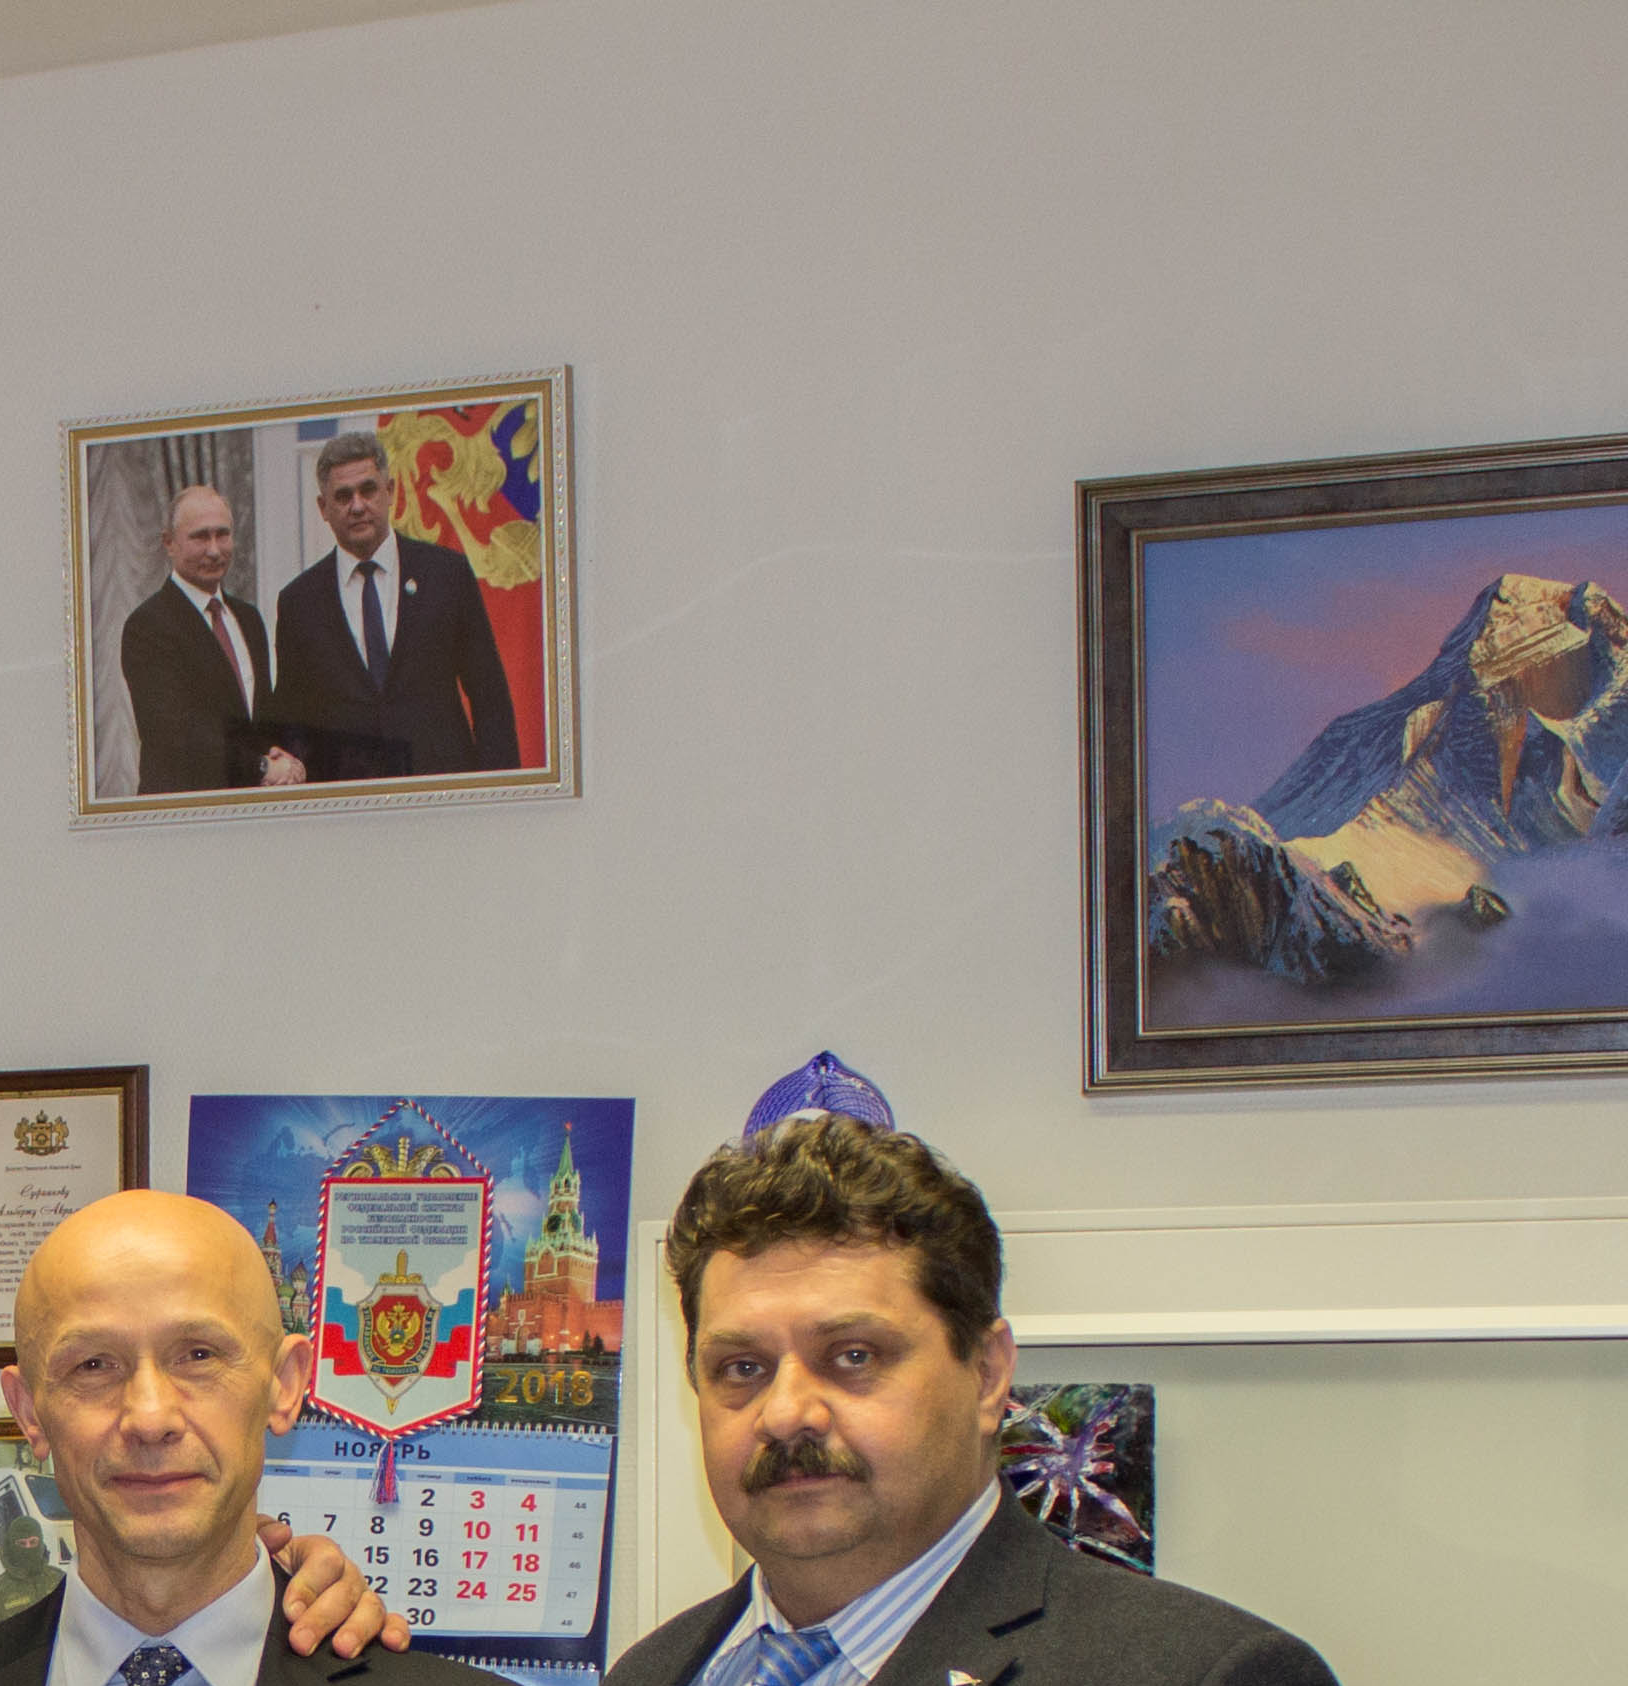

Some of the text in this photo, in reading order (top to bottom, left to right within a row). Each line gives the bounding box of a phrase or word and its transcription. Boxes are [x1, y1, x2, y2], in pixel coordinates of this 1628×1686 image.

[494, 1368, 595, 1408] 2018
[420, 1488, 435, 1507] 2
[470, 1490, 486, 1509] 3
[521, 1493, 537, 1512] 4
[323, 1514, 337, 1532] 7
[370, 1516, 385, 1535] 8
[419, 1518, 435, 1537] 9
[463, 1521, 491, 1540] 10
[515, 1523, 539, 1543] 11
[364, 1546, 390, 1565] 15
[413, 1548, 439, 1567] 16
[462, 1550, 489, 1569] 17
[512, 1553, 540, 1573] 18
[408, 1577, 438, 1597] 23
[456, 1580, 488, 1600] 24
[506, 1583, 537, 1602] 25
[407, 1607, 436, 1626] 30
